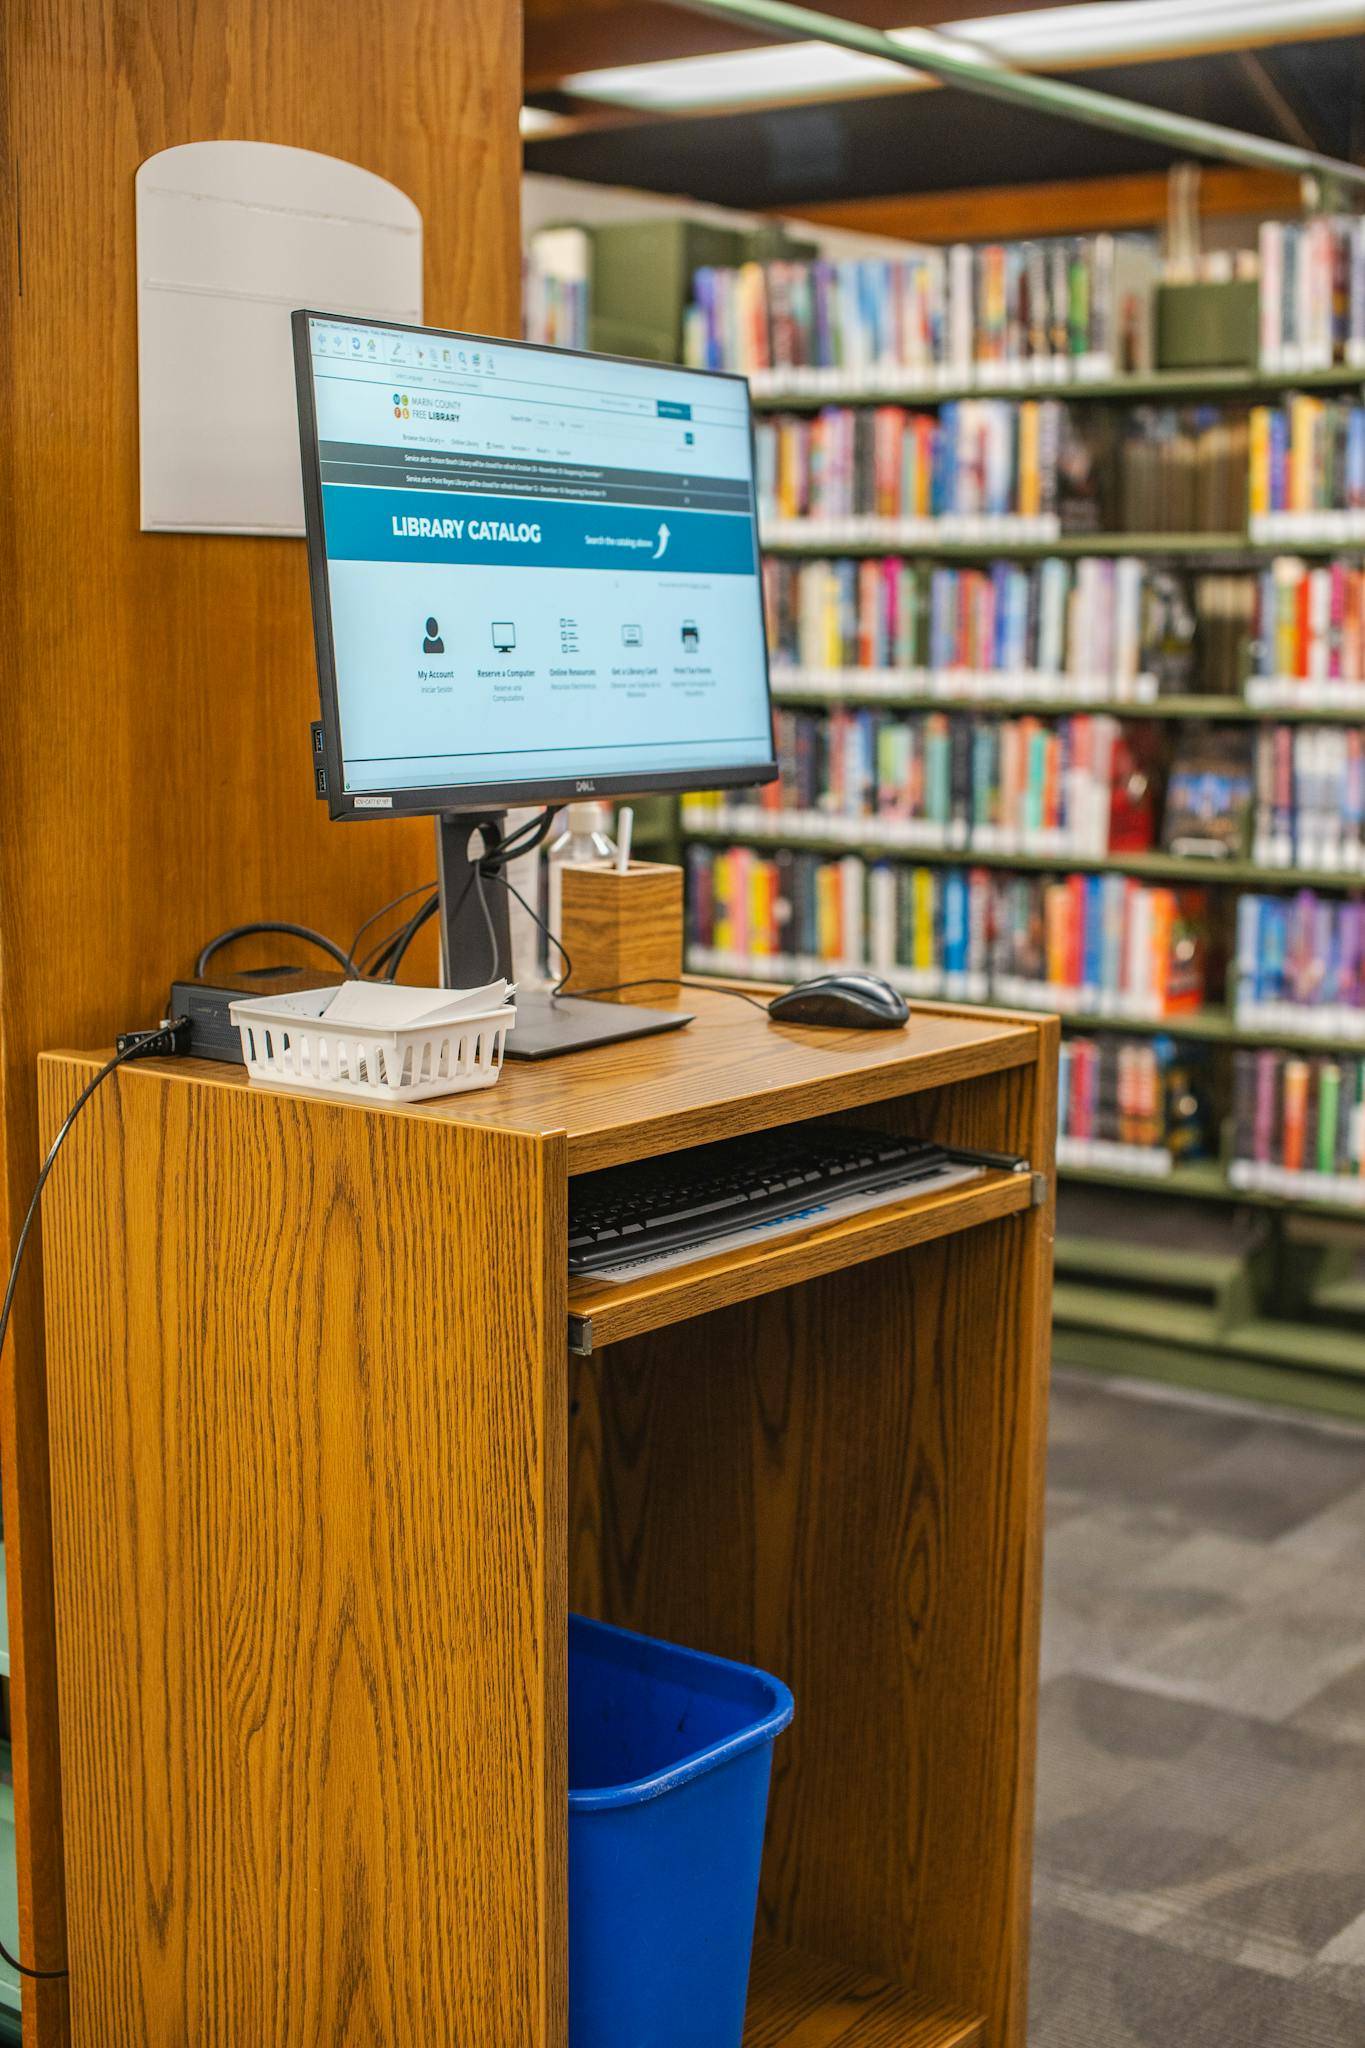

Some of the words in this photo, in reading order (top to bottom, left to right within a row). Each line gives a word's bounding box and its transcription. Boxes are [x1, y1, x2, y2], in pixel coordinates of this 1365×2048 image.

[412, 397, 432, 407] MARIN
[435, 399, 461, 409] COUNTY
[413, 409, 427, 419] FREE
[428, 411, 460, 422] LIBRARY
[404, 454, 420, 462] Service
[392, 516, 464, 539] LIBRARY
[468, 520, 542, 543] CATALOG
[584, 534, 603, 545] Search
[604, 536, 615, 545] the
[616, 537, 637, 549] catalog
[417, 670, 427, 680] My
[428, 670, 454, 679] Account
[477, 669, 501, 678] Reserve
[507, 669, 536, 679] Computer
[550, 668, 568, 677] Online
[569, 668, 596, 677] Resources
[576, 780, 595, 792] DELL
